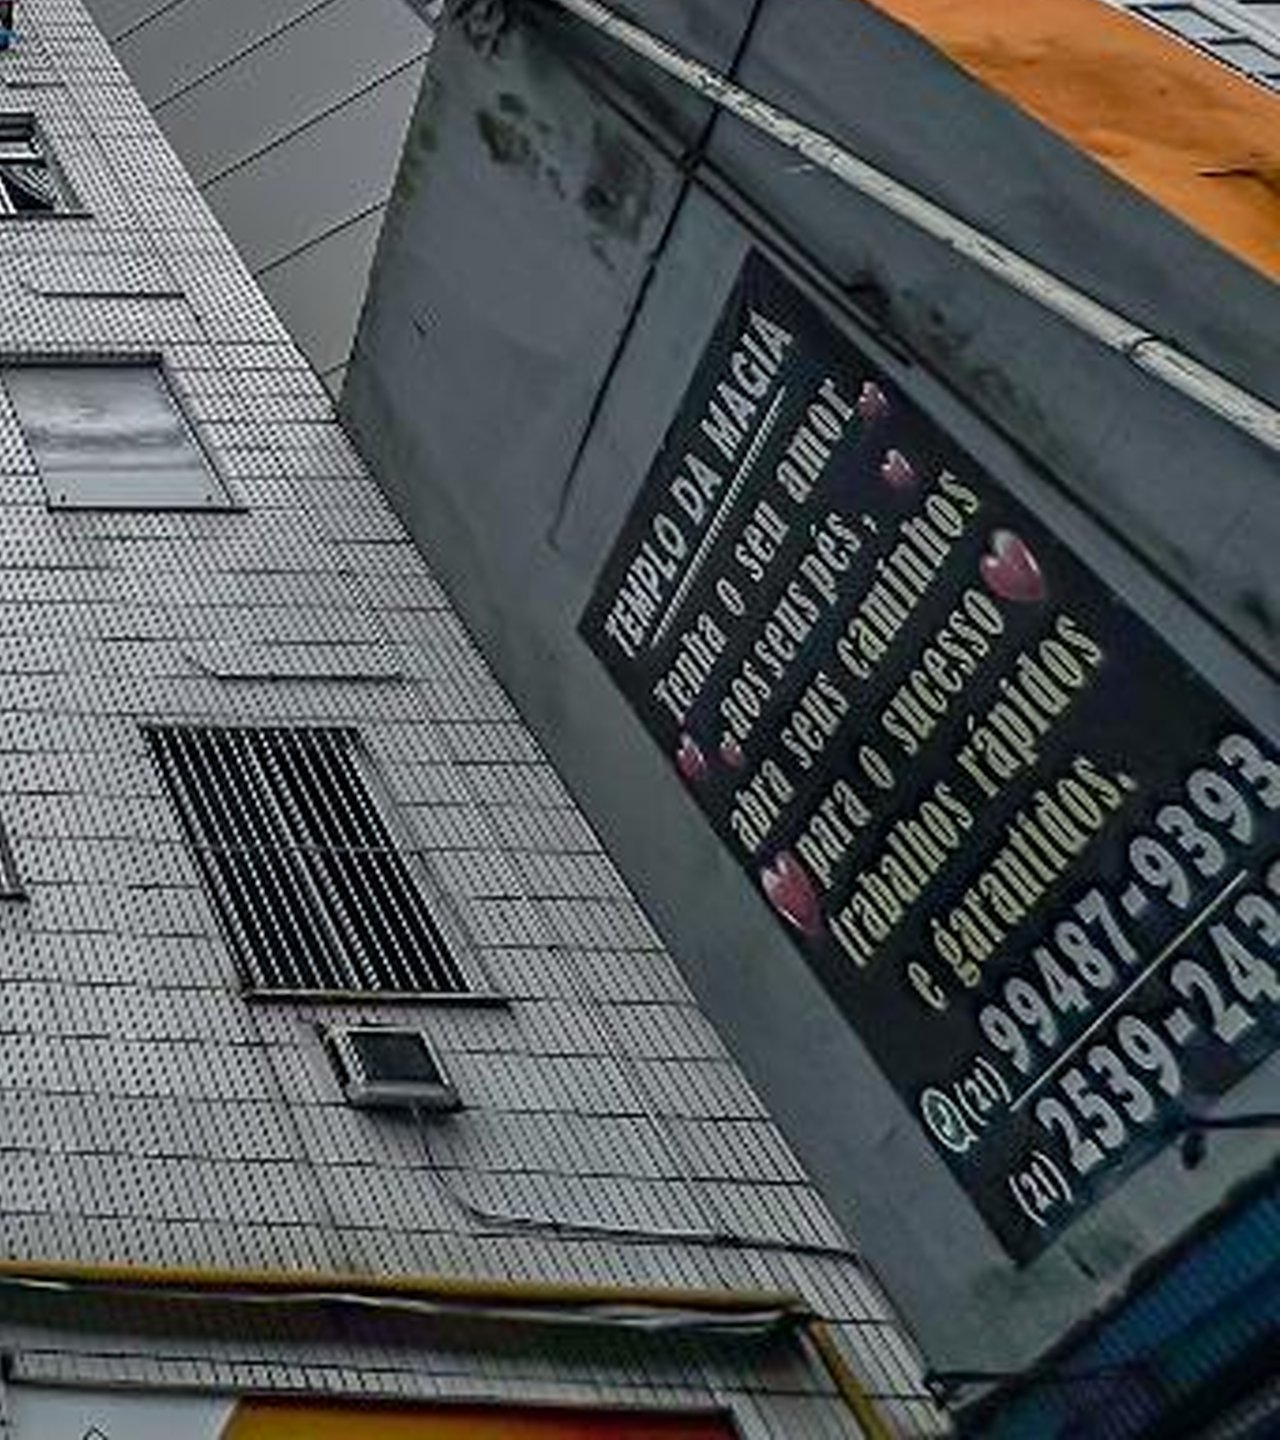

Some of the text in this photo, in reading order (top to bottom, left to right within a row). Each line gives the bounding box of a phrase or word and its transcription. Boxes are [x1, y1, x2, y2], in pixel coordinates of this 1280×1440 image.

[604, 308, 794, 658] TEMPLO DA MAGIA
[653, 377, 854, 723] Tenha o seu amor
[720, 659, 771, 740] aos
[754, 580, 820, 680] seus
[731, 469, 980, 853] abra seus caminhos
[796, 587, 1005, 890] para o sucesso
[828, 613, 1103, 969] trabalhos rápidos
[908, 960, 948, 1011] e
[952, 733, 1280, 1127] (21) 99487-9393
[1008, 1150, 1074, 1227] (21)
